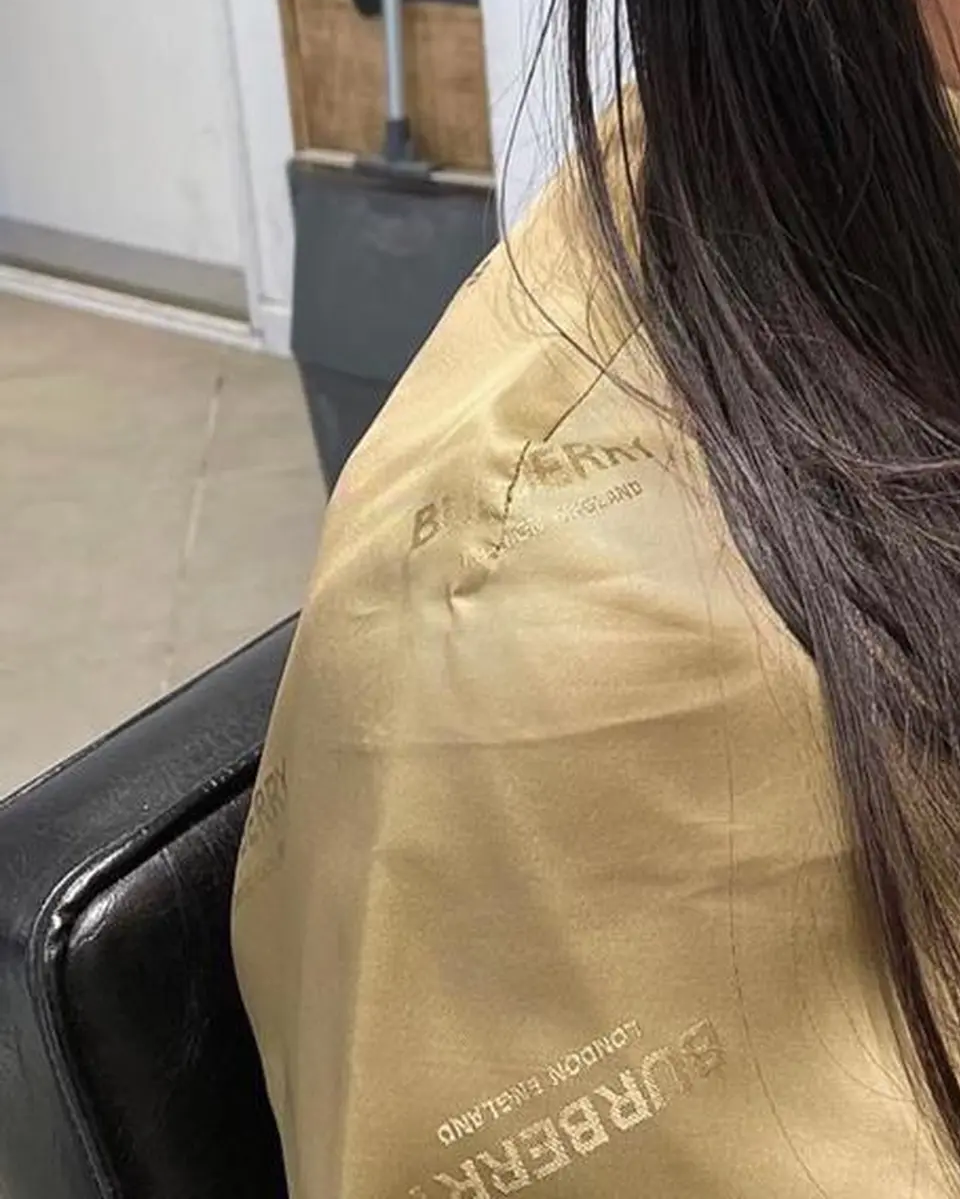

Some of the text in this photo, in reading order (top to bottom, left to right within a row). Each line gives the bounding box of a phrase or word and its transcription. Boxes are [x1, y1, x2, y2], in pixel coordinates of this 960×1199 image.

[408, 1017, 727, 1199] BURBERR
[436, 1019, 643, 1147] LONDON ENGLAND
